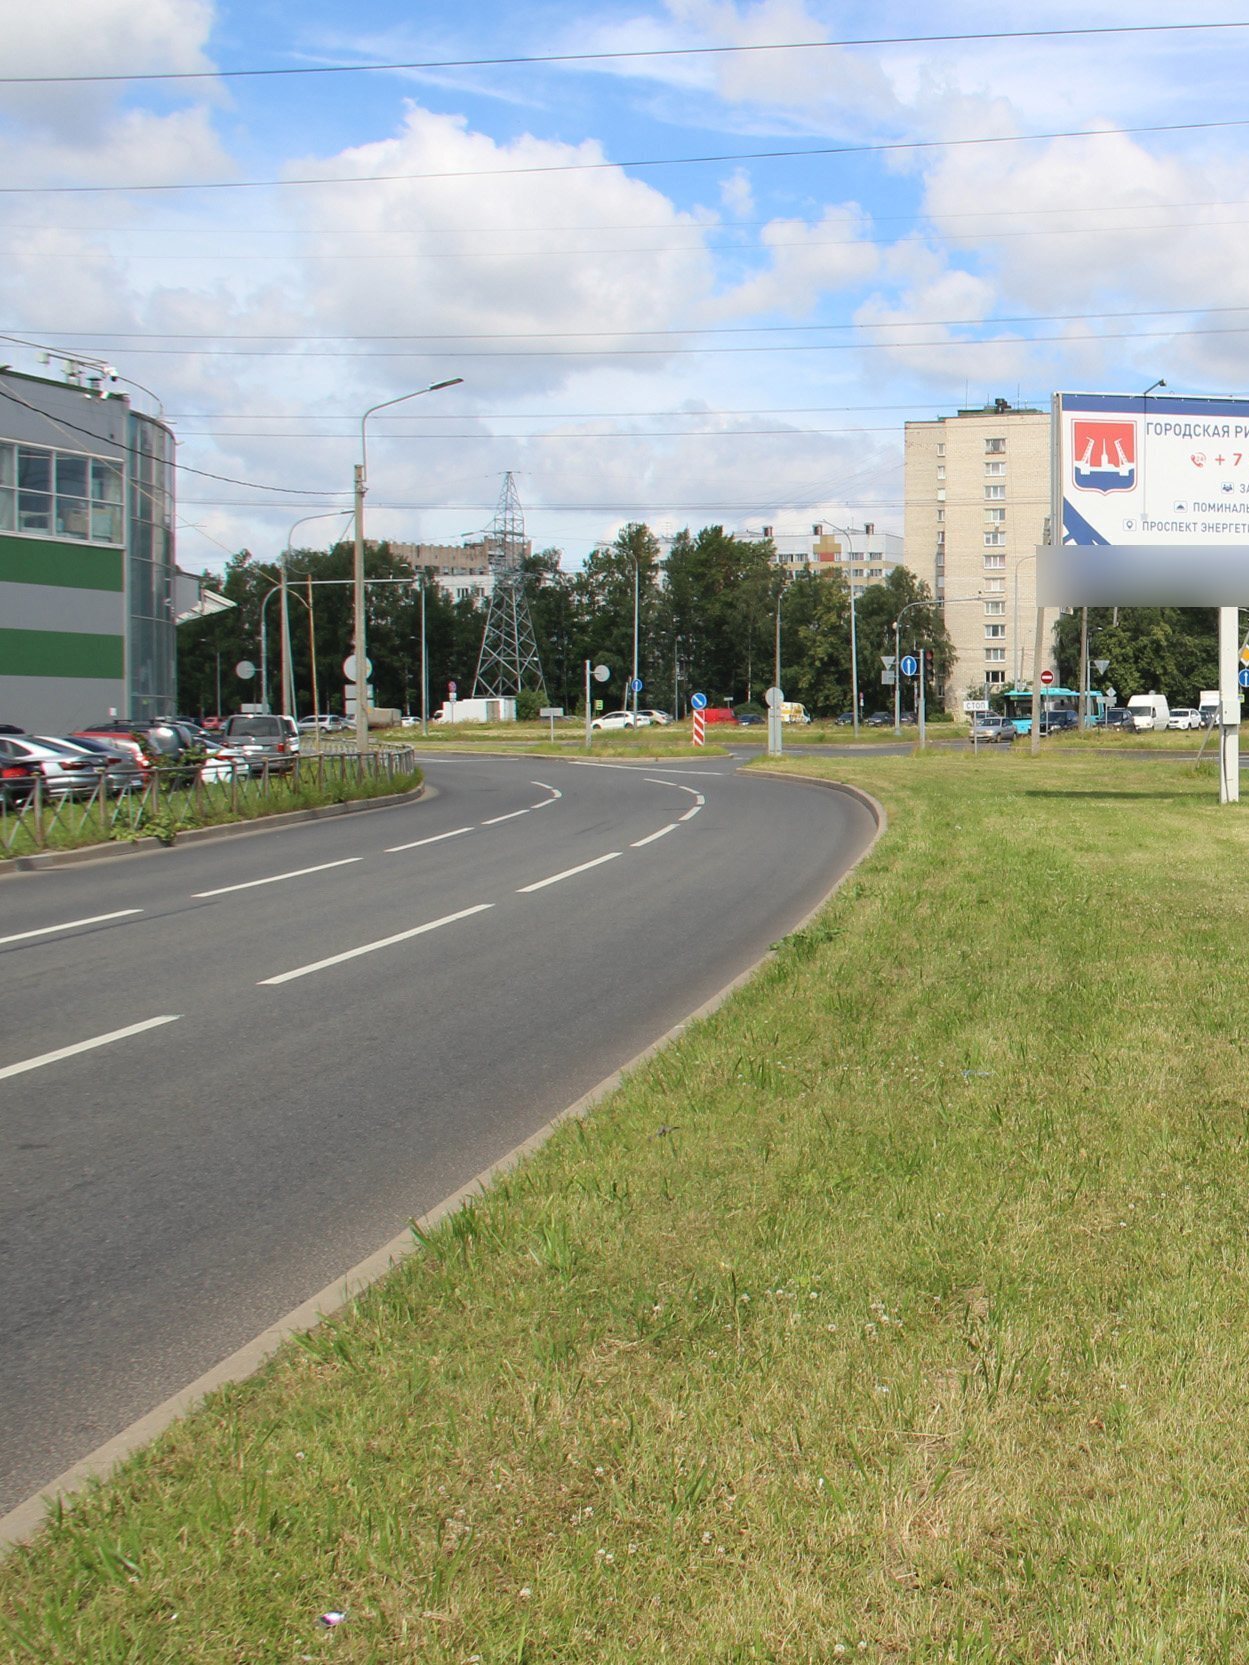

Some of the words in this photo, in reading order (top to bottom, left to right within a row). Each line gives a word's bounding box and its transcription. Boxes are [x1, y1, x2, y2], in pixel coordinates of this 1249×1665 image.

[1146, 422, 1230, 439] ГОРОДСКАЯ
[1233, 453, 1243, 466] 7
[1142, 521, 1198, 532] ПРОСПЕКТ
